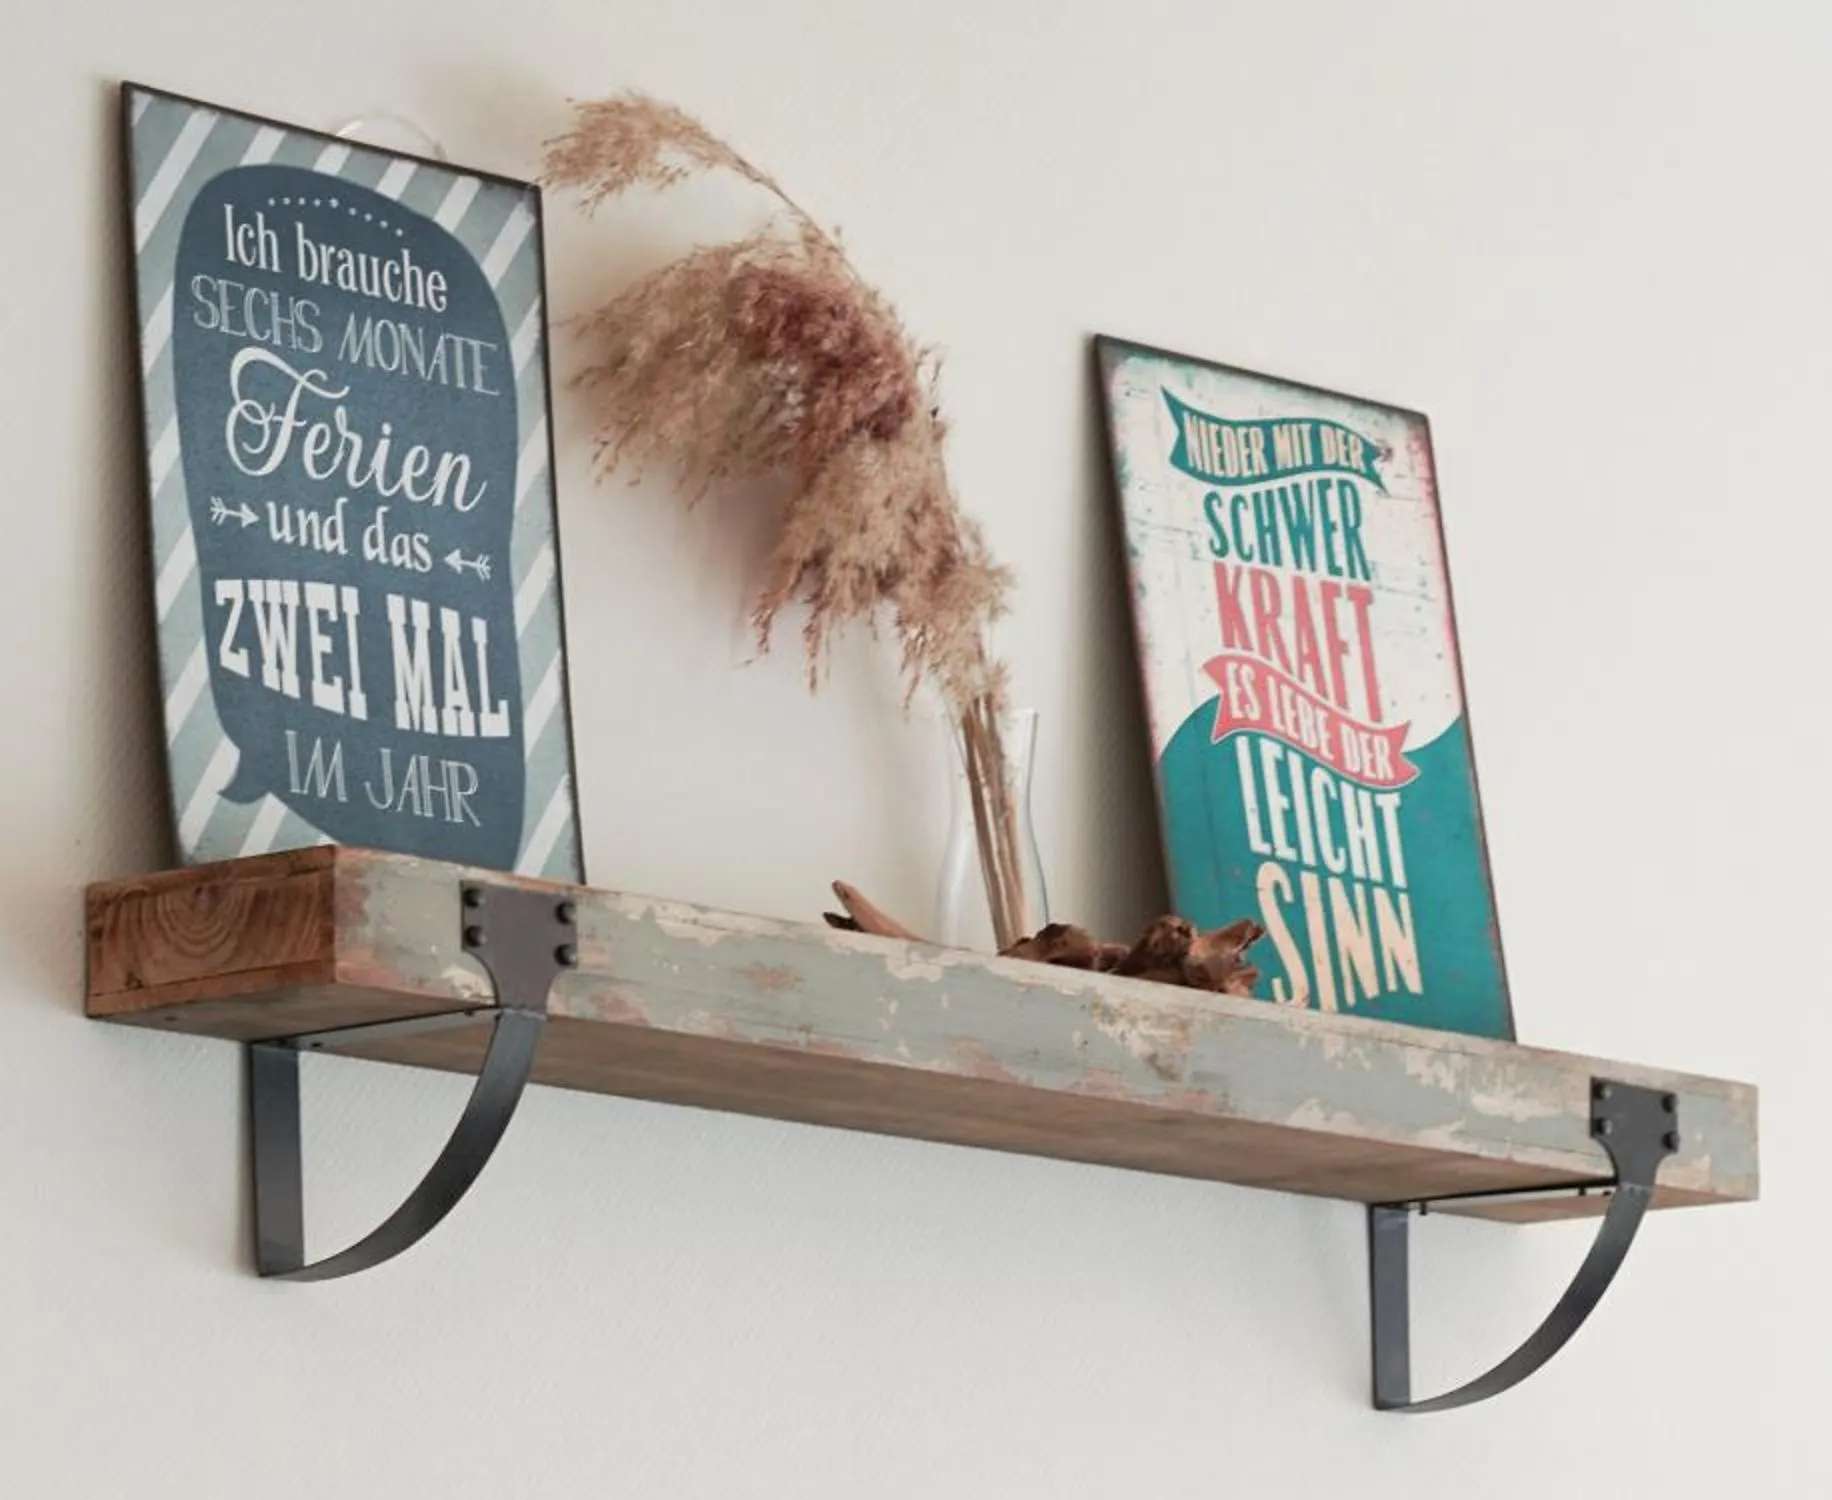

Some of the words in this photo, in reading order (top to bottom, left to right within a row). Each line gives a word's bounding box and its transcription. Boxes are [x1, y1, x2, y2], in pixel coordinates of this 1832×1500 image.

[224, 204, 281, 272] Ich
[296, 222, 448, 312] brauche
[191, 276, 323, 354] SECHS
[337, 310, 500, 396] MONATE
[225, 346, 487, 512] Ferien
[1183, 410, 1268, 478] NIEDER
[1272, 424, 1312, 470] MIT
[1320, 425, 1365, 473] DER
[266, 498, 348, 556] und
[362, 506, 433, 573] das
[1203, 478, 1371, 581] SCHWER
[215, 579, 368, 721] ZWEI
[386, 593, 511, 737] MAL
[1213, 561, 1384, 723] KRAFT
[285, 729, 348, 802] IM
[364, 748, 481, 828] JAHR
[1225, 661, 1260, 721] ES
[1266, 675, 1336, 762] LEBE
[1340, 723, 1395, 781] DER
[1235, 736, 1408, 889] LEICHT
[1256, 862, 1423, 1013] SINN
